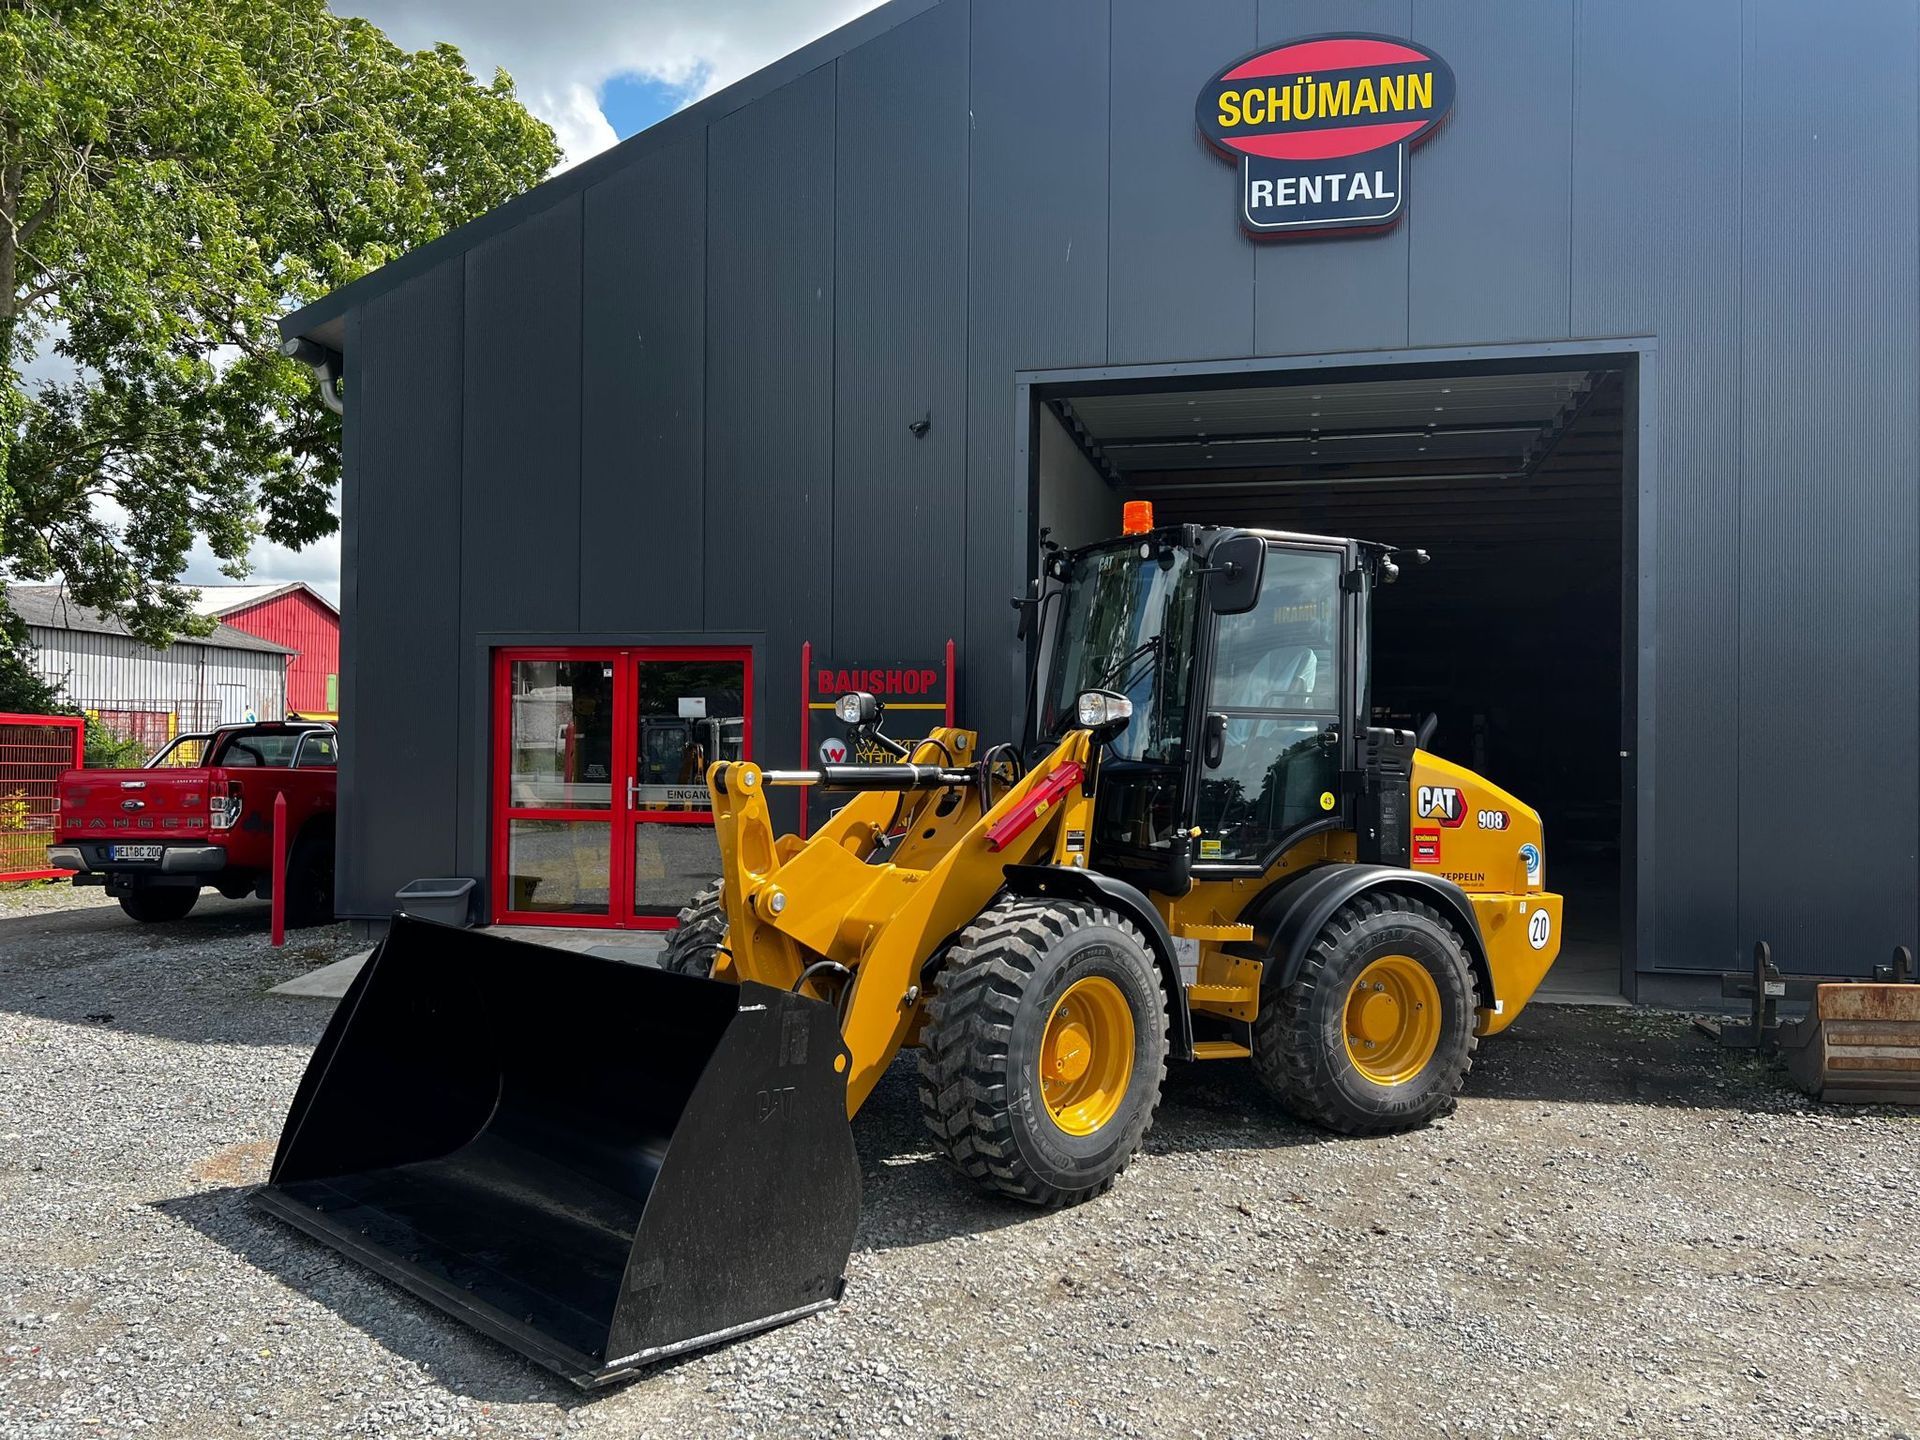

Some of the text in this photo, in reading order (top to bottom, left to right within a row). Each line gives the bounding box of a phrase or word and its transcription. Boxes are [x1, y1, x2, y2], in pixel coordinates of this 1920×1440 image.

[1217, 73, 1433, 127] SCHÜMANN
[1251, 170, 1395, 208] RENTAL
[819, 671, 937, 694] BAUSHOP
[1418, 786, 1456, 818] CAT
[66, 818, 204, 828] RANGER
[1478, 810, 1503, 829] 908
[134, 847, 145, 857] BC
[147, 847, 161, 857] 200
[1441, 872, 1485, 881] ZEPPELIN
[1533, 917, 1547, 941] 20
